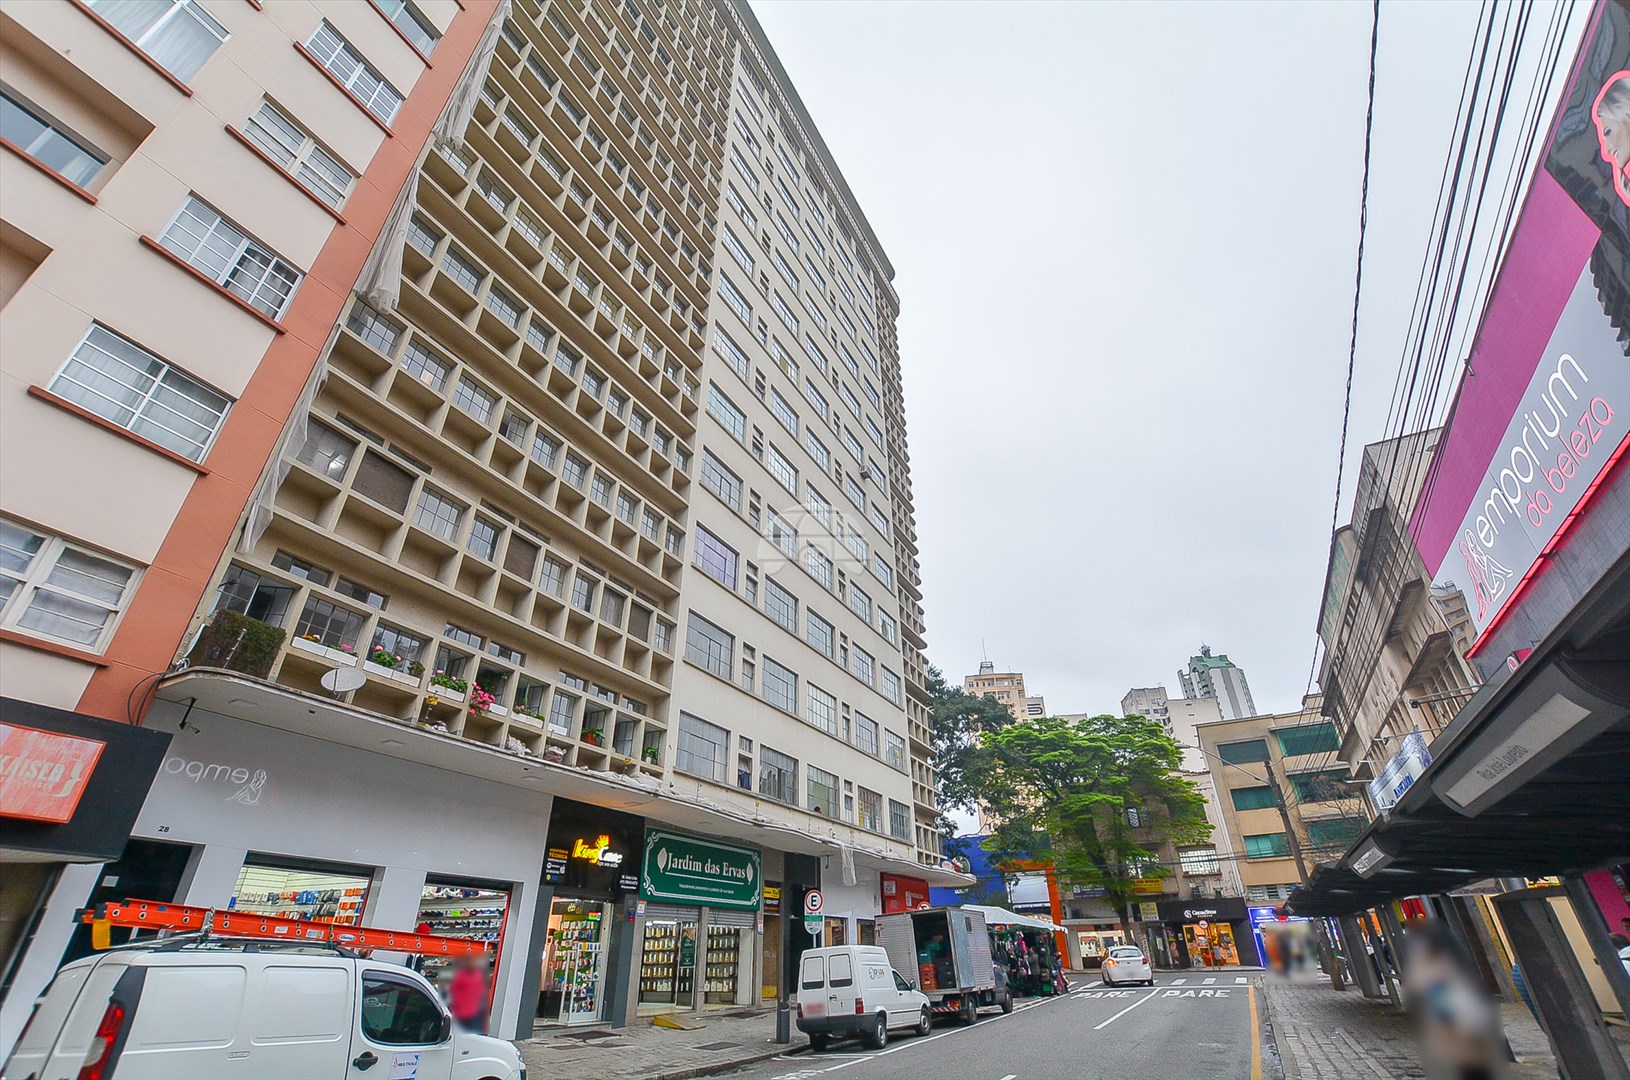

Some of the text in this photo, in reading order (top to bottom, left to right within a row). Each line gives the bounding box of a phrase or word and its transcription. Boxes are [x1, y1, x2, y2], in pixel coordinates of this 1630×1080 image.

[1475, 353, 1589, 548] emporium
[1526, 396, 1615, 528] da beleza
[158, 825, 170, 833] 28
[667, 852, 746, 879] Jardim das Ervas
[811, 895, 817, 907] E
[1070, 990, 1136, 999] PARE
[1161, 989, 1231, 998] PARE
